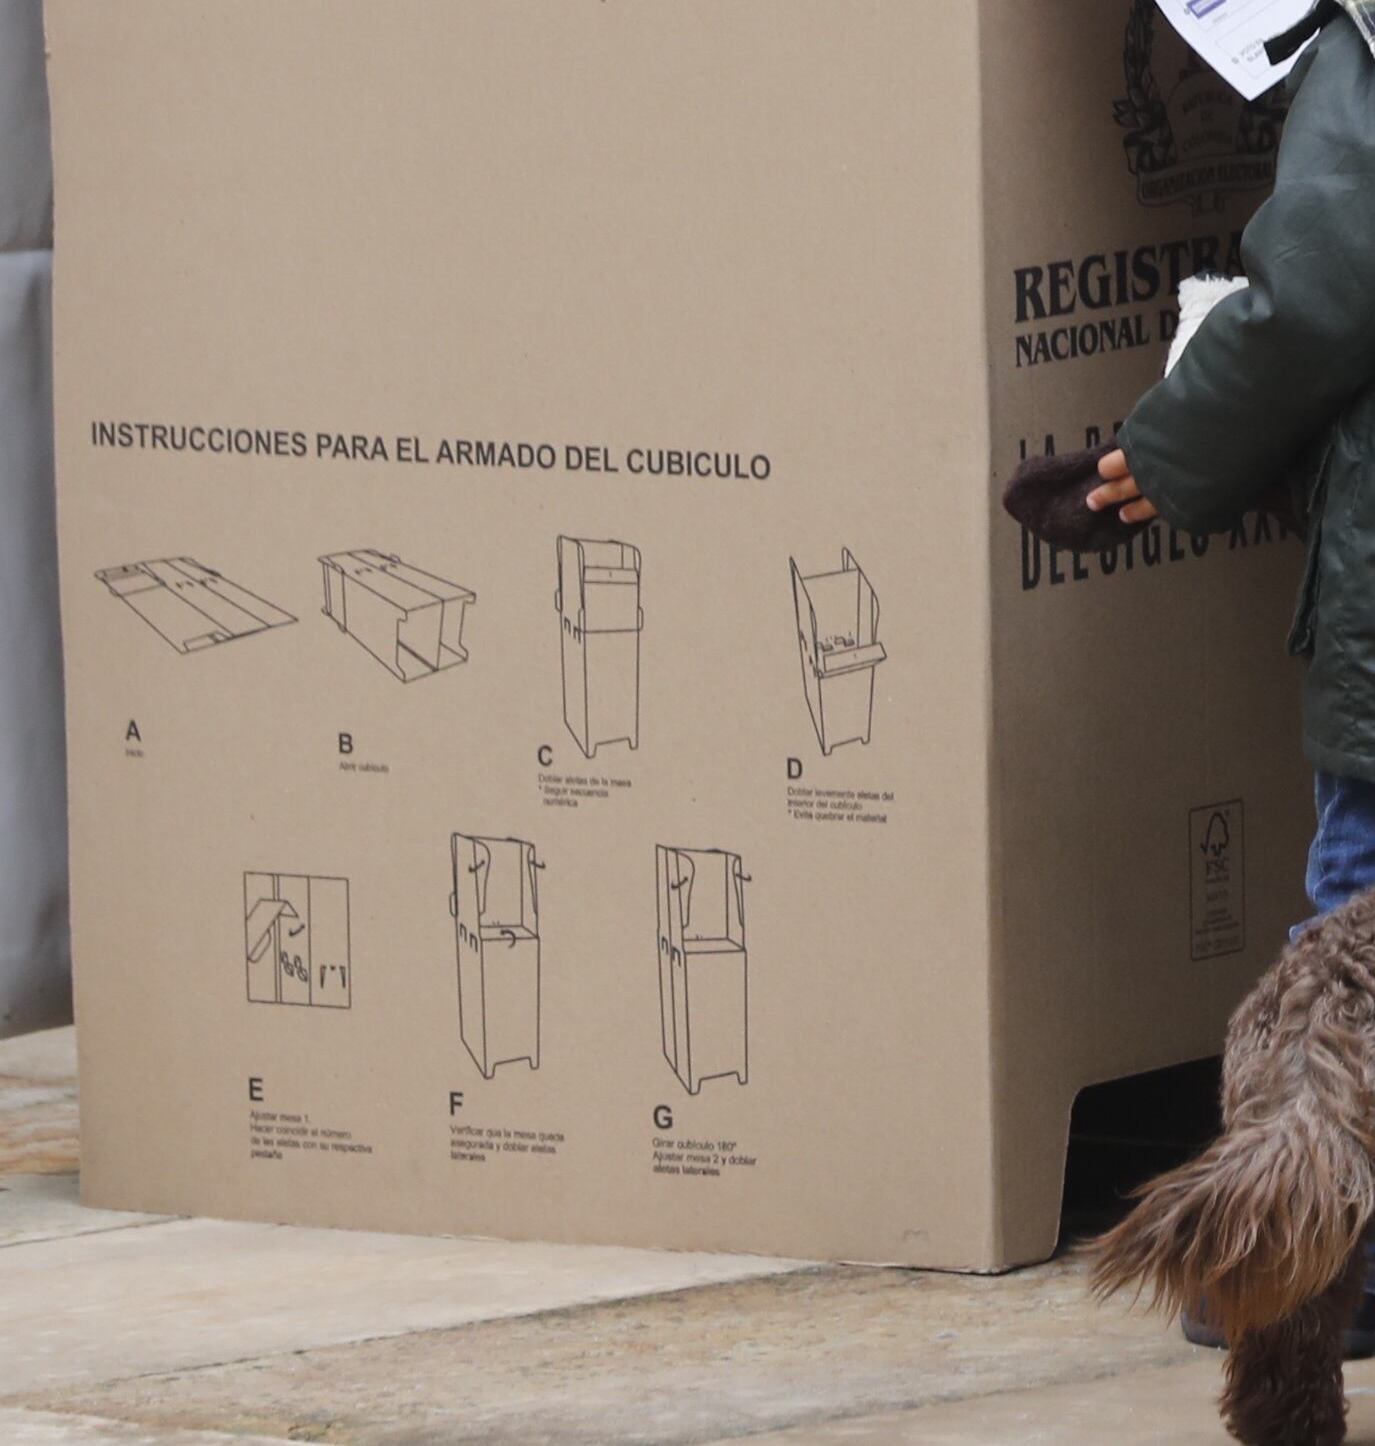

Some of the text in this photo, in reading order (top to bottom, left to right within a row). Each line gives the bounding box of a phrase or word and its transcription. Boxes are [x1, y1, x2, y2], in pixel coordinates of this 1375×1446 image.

[1015, 314, 1150, 367] NACIONAL
[91, 420, 771, 480] INSTRUCCIONES PARA EL ARMADO DEL CUBICULO
[125, 719, 141, 742] A
[338, 732, 353, 754] B
[538, 745, 553, 767] C
[787, 757, 803, 779] D
[249, 1077, 264, 1101] E
[450, 1092, 463, 1116] F
[653, 1104, 673, 1130] G
